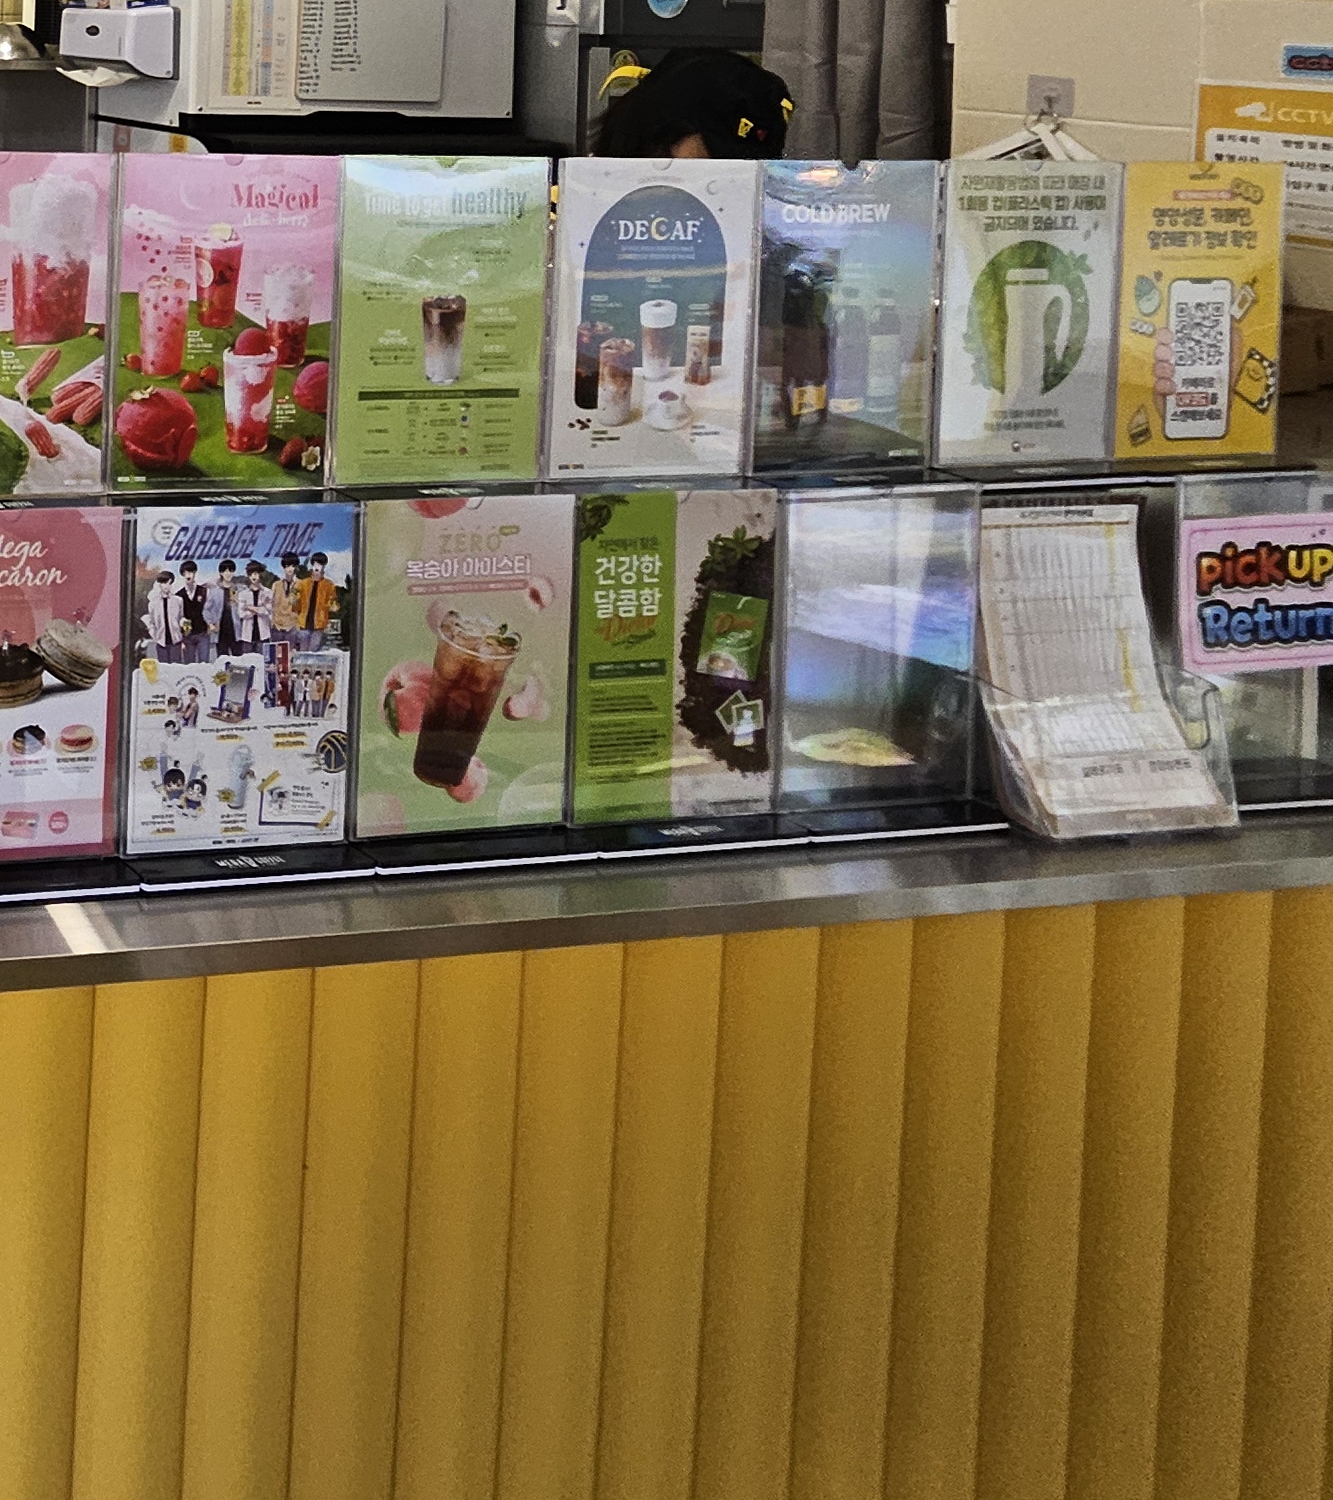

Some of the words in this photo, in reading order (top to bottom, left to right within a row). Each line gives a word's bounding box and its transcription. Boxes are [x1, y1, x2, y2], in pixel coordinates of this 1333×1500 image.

[1277, 108, 1333, 125] CCTV
[233, 182, 320, 211] Magical
[782, 203, 834, 224] COLD
[836, 203, 890, 223] BREW
[618, 217, 701, 242] DECAF
[165, 524, 265, 561] GARBAGE
[265, 523, 324, 558] TIME
[440, 534, 502, 554] ZERO
[407, 558, 458, 579] 복숭아
[462, 556, 532, 577] 아이스티
[595, 554, 662, 585] 건강한
[594, 588, 663, 618] 달콤함
